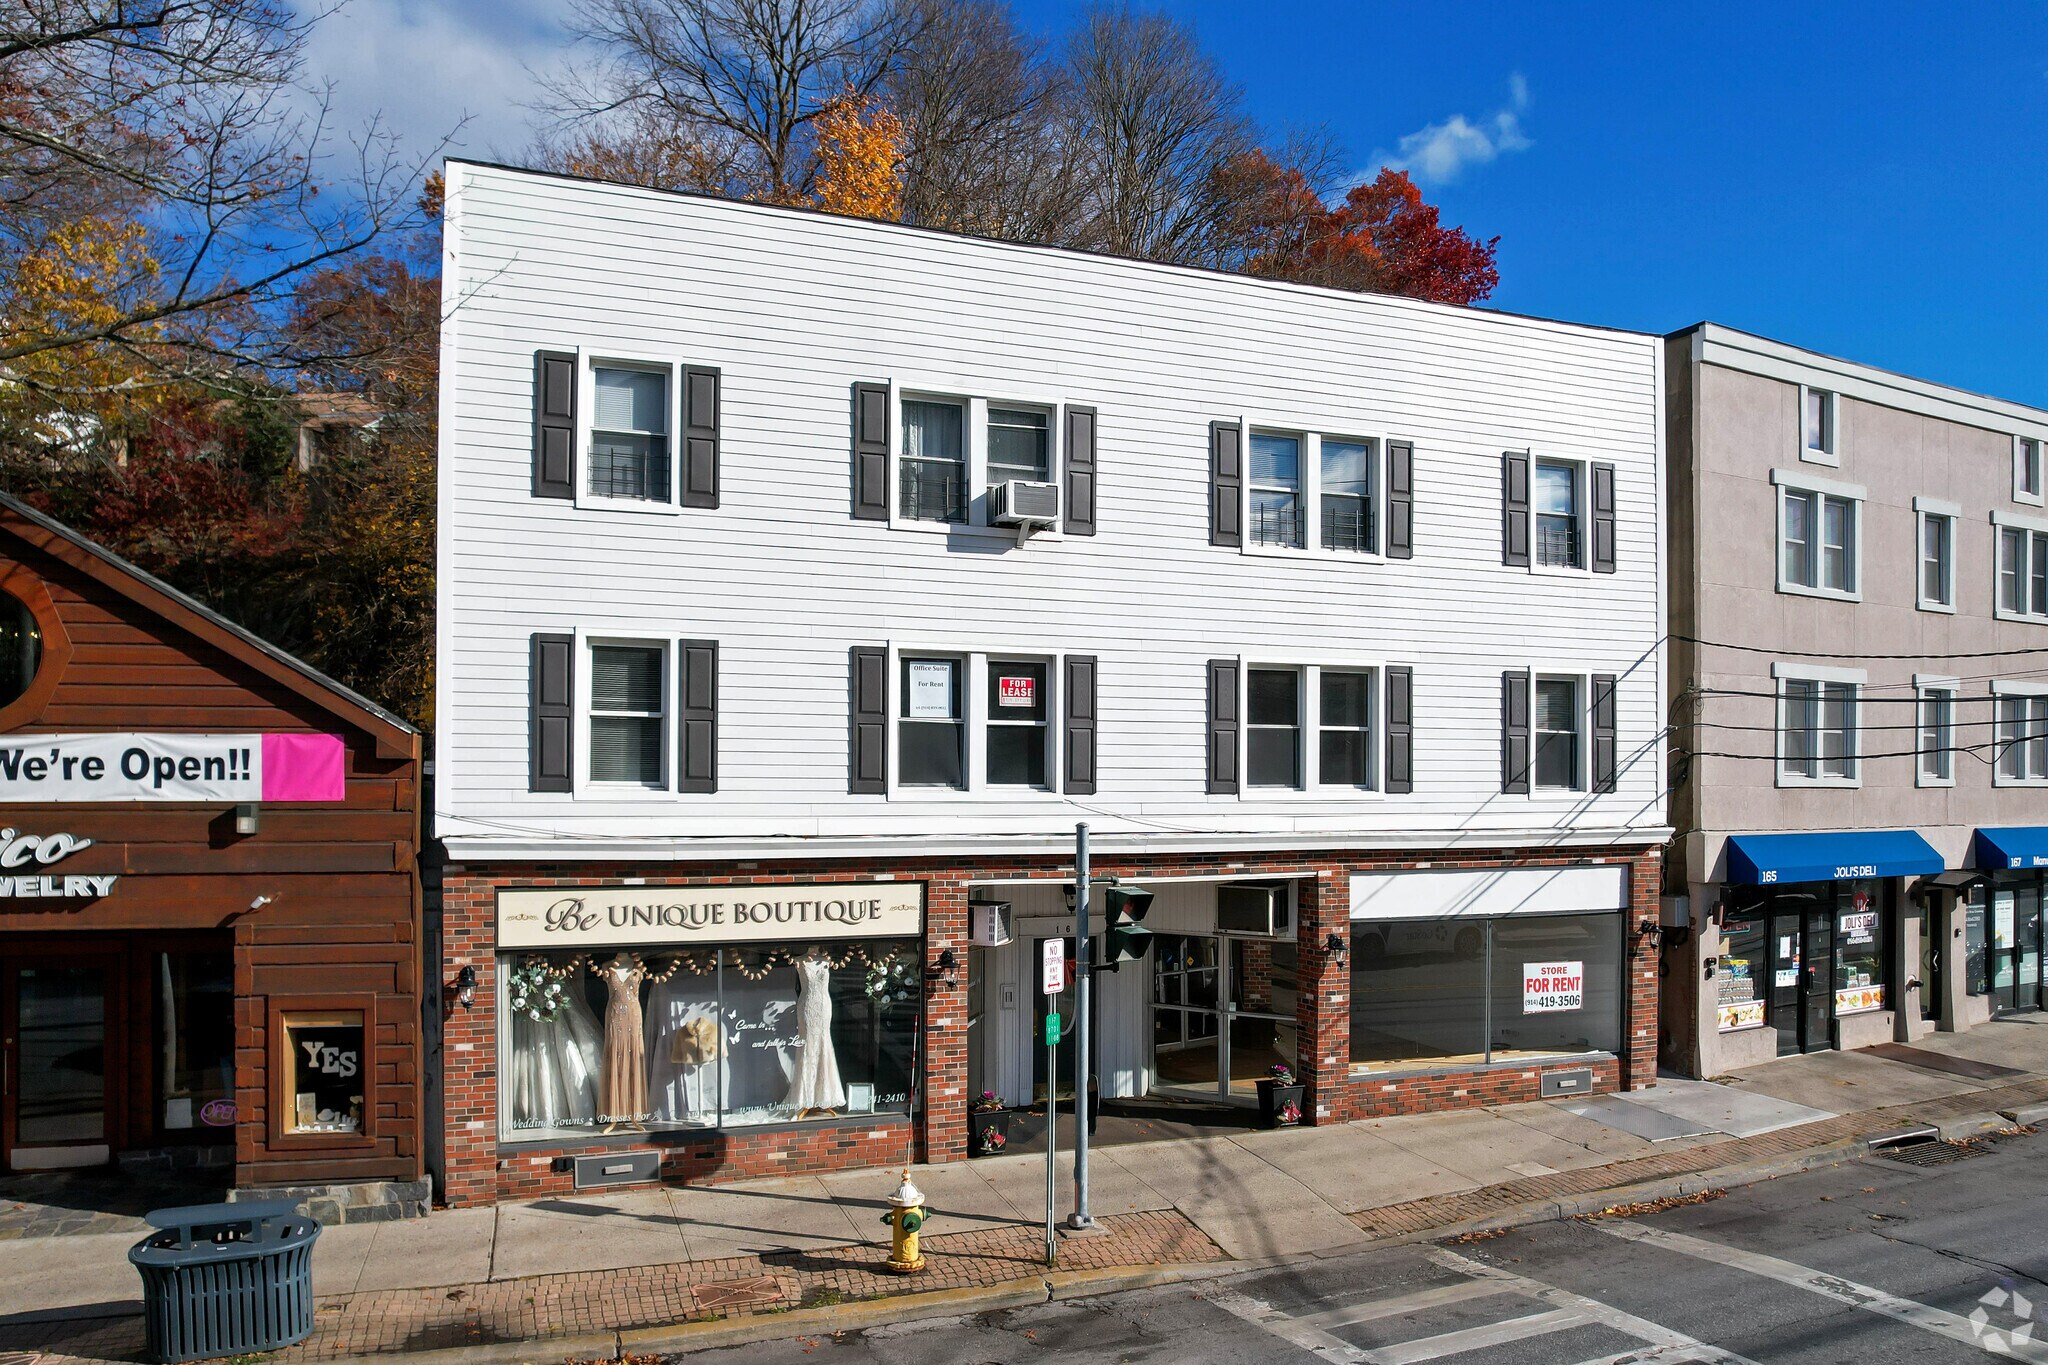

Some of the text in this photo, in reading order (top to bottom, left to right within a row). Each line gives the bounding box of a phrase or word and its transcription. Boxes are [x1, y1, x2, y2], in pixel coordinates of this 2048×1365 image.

[1002, 687, 1034, 697] LEASE
[120, 747, 250, 789] Open!!
[2010, 857, 2022, 868] 167
[1762, 865, 1877, 883] 165 JOLI'S DELI
[544, 897, 883, 932] Be UNIQUE BOUTIQUE
[1049, 946, 1058, 956] NO
[1540, 966, 1568, 975] STORE
[1526, 977, 1581, 993] FOR RENT
[1538, 995, 1581, 1008] 419-3506
[302, 1041, 357, 1078] YES
[551, 1115, 585, 1129] Gowns
[597, 1113, 632, 1126] Dresses
